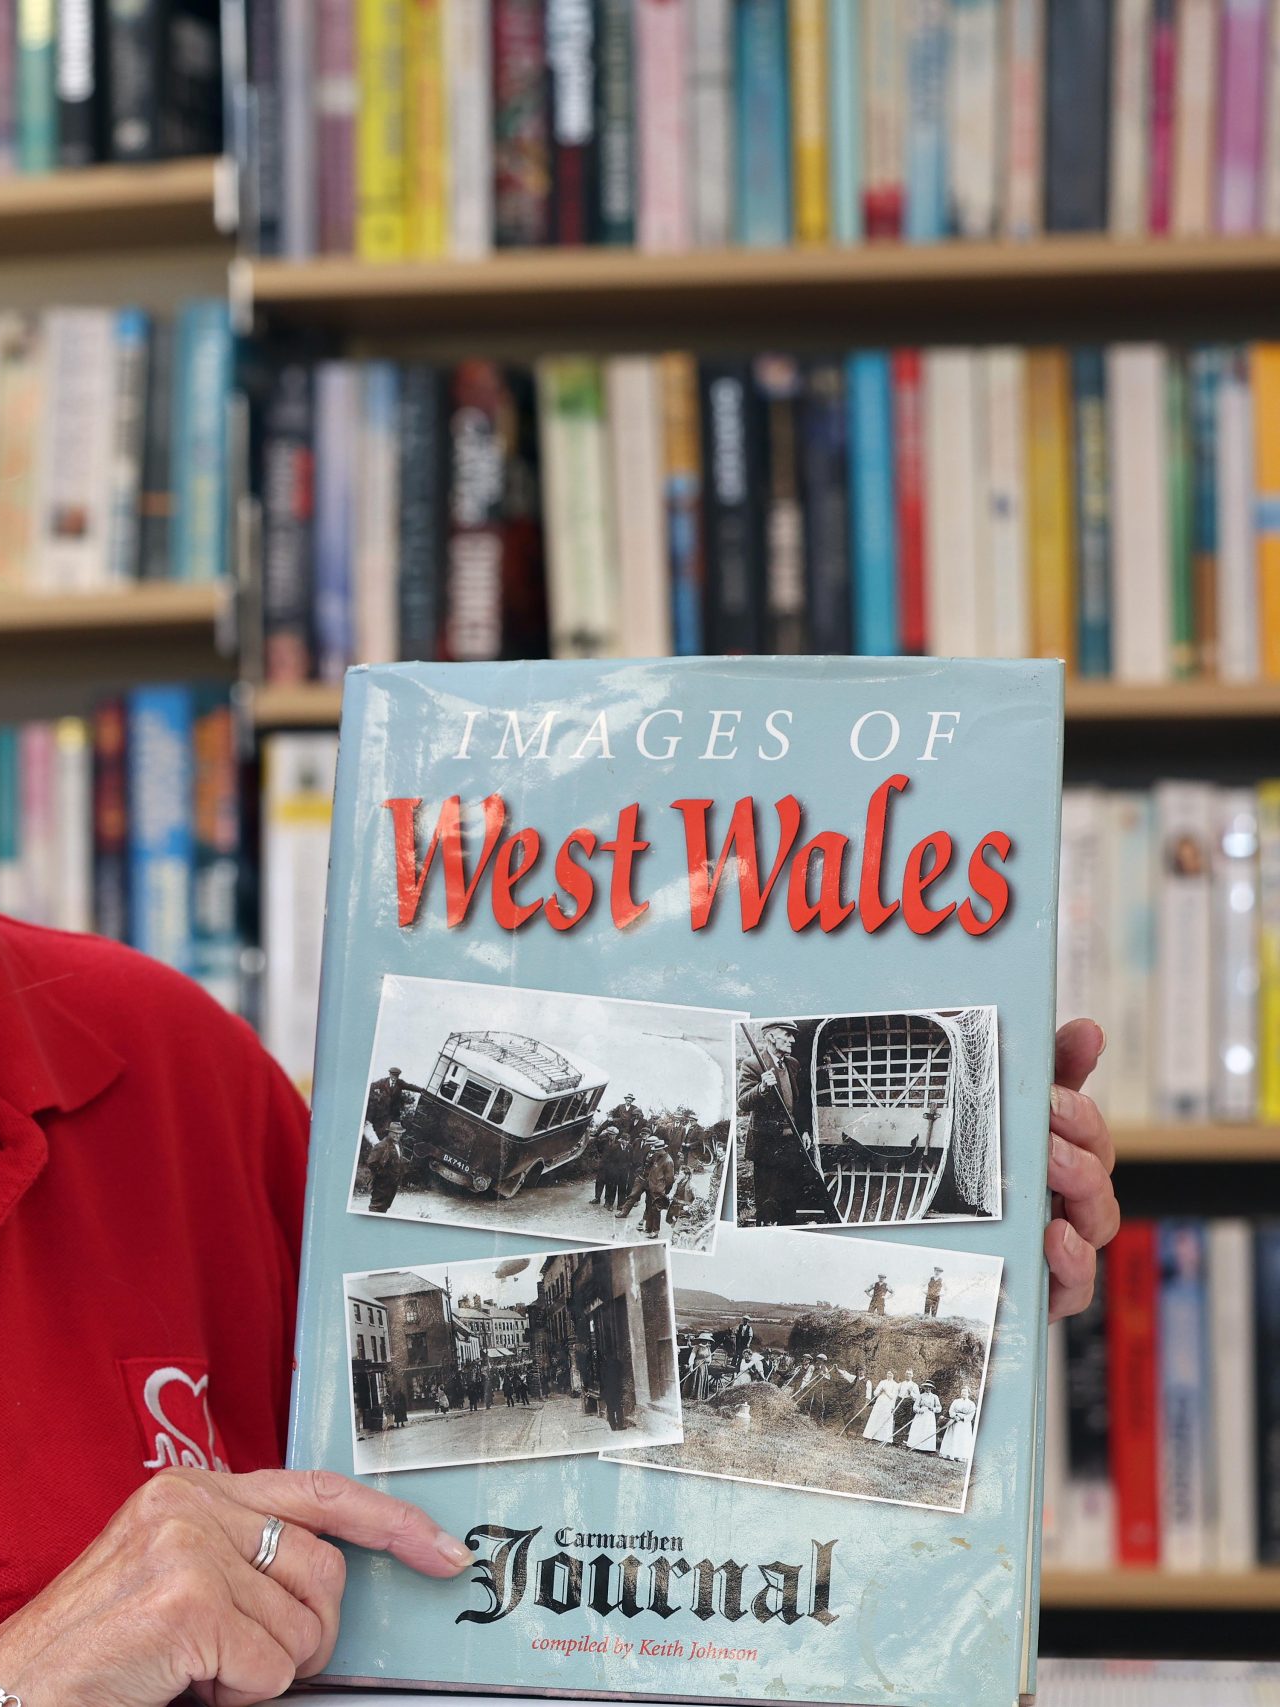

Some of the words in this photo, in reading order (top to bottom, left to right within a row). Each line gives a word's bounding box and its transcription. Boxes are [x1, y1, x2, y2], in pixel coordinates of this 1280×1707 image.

[452, 708, 794, 761] IMAGES
[849, 708, 962, 762] OF
[380, 793, 651, 931] West
[669, 773, 1013, 937] Wales
[553, 1526, 685, 1553] Carmarthen
[454, 1524, 841, 1628] Journal
[531, 1635, 609, 1656] compiled
[613, 1637, 634, 1661] by
[638, 1639, 685, 1658] Keith
[687, 1641, 759, 1662] Johnson
